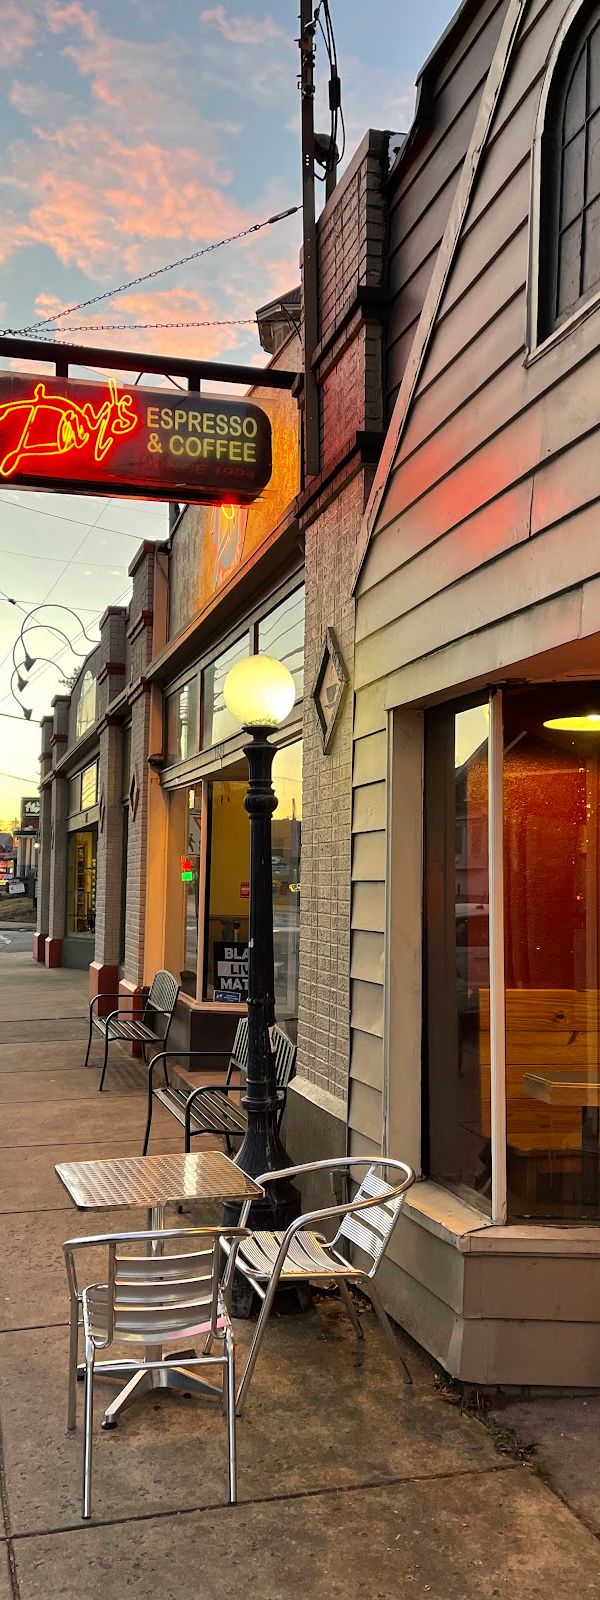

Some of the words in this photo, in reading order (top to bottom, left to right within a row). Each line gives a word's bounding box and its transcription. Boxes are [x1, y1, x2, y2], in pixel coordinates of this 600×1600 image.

[146, 406, 258, 439] ESPRESSO
[147, 432, 163, 454] &
[169, 435, 257, 463] COFFEE
[224, 947, 249, 960] BLA
[230, 964, 249, 975] LIV
[220, 978, 249, 991] MAT
